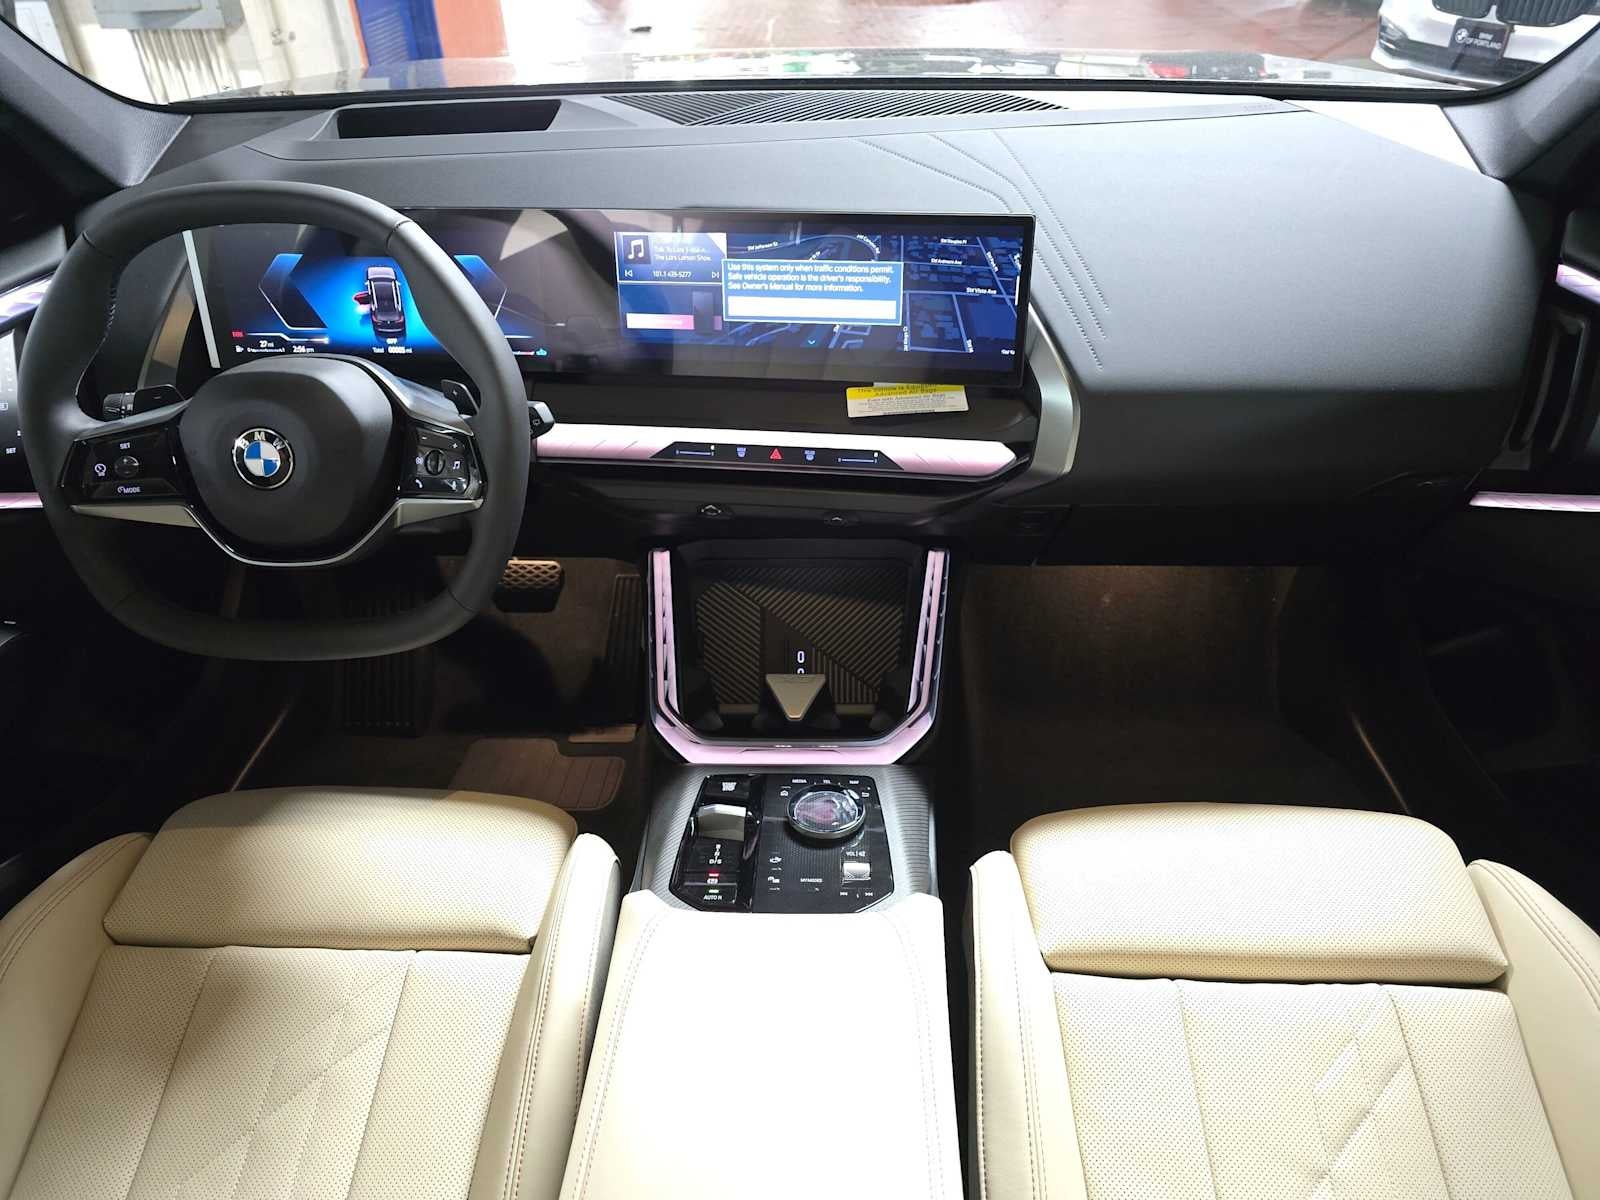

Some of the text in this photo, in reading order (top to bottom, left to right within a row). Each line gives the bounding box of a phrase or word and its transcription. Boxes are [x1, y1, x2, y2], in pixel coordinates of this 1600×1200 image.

[728, 263, 740, 271] Use
[741, 263, 754, 271] this
[755, 264, 779, 273] system
[780, 264, 794, 274] only
[795, 265, 813, 273] when
[814, 265, 833, 273] traffic
[834, 265, 869, 274] conditions
[728, 272, 742, 281] Safe
[743, 273, 767, 281] vehicle
[768, 273, 800, 283] operation
[807, 274, 819, 282] the
[820, 274, 844, 283] driver's
[845, 275, 891, 285] responsibility.
[728, 281, 864, 293] See Owner's Manual for more information.
[240, 431, 286, 450] BMW
